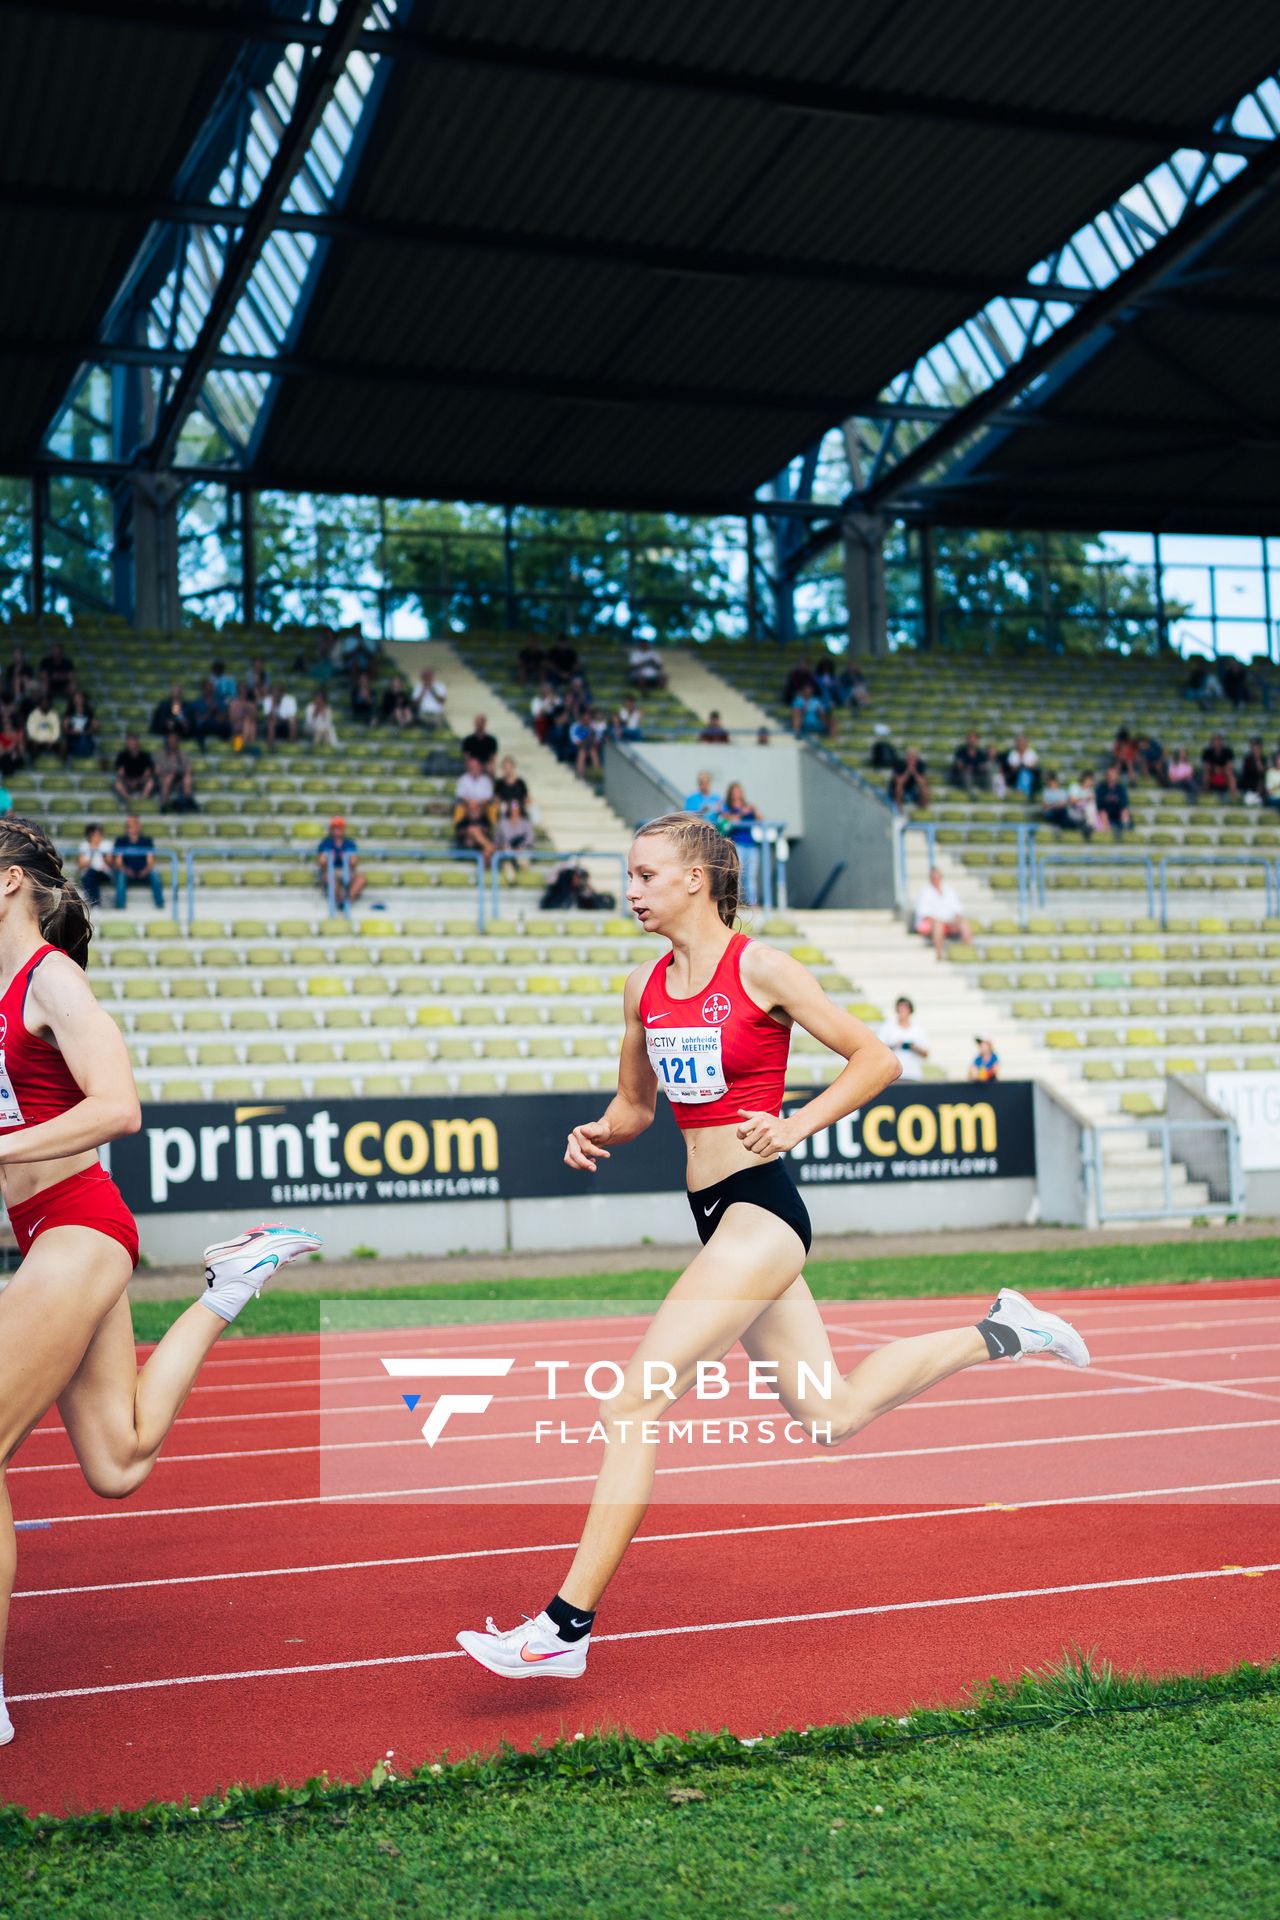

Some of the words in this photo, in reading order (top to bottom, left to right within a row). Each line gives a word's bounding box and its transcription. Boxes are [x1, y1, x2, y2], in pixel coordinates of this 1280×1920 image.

[681, 1036, 717, 1044] Lohrheide
[682, 1043, 718, 1052] MEETING
[659, 1057, 698, 1084] 121
[147, 1107, 500, 1203] printcom
[800, 1160, 885, 1182] SIMPLIFY
[890, 1157, 998, 1178] WORKFLOWS
[271, 1181, 369, 1203] SIMPLIFY
[375, 1176, 500, 1199] WORKFLOWS
